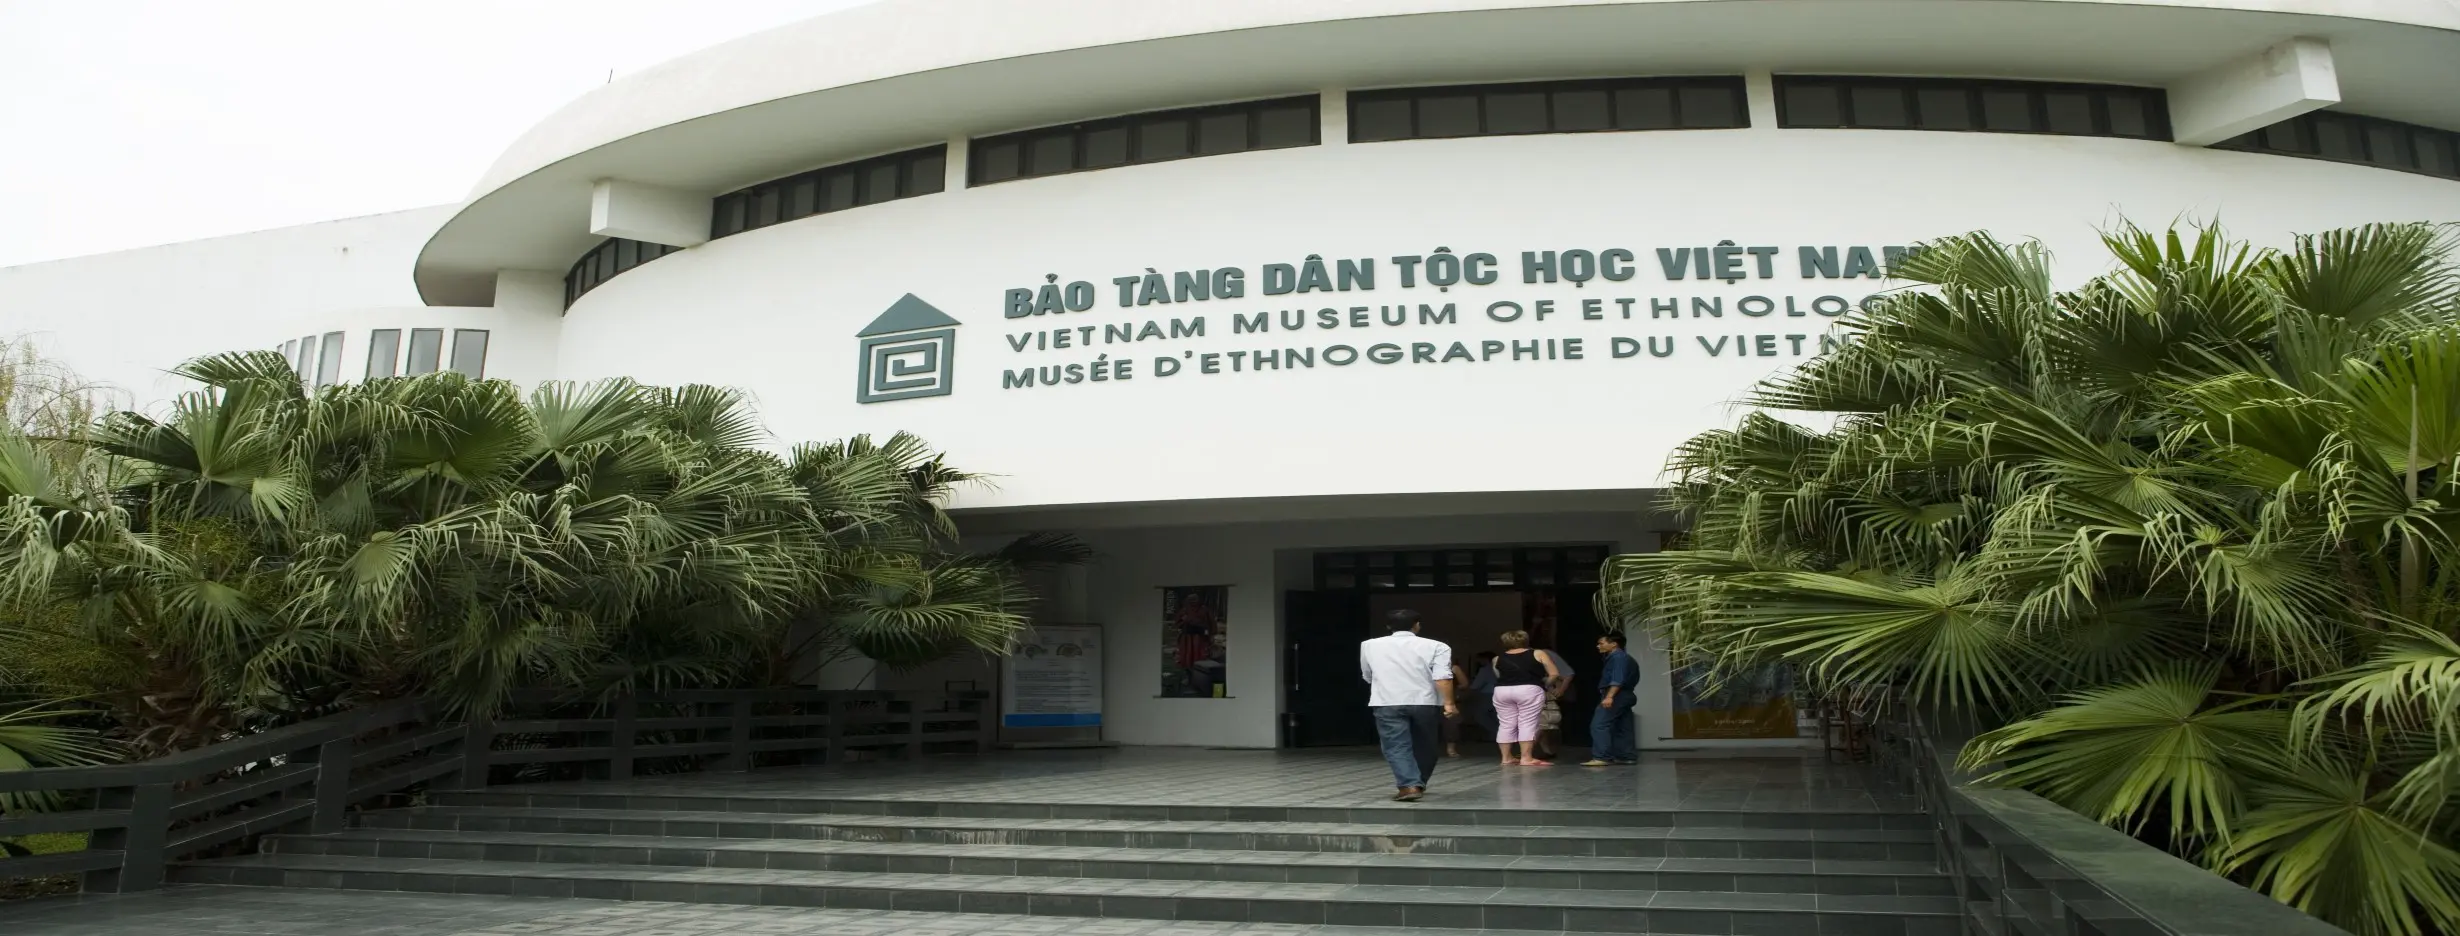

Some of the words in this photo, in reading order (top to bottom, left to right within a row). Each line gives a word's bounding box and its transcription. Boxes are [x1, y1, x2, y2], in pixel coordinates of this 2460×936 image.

[1004, 272, 1095, 320] BẢO
[1112, 266, 1245, 308] TÀNG
[1262, 253, 1376, 297] DÂN
[1391, 246, 1499, 293] TỘC
[1521, 248, 1636, 289] HỌC
[1655, 239, 1780, 285] VIỆT
[1005, 316, 1206, 353] VIETNAM
[1233, 302, 1457, 335] MUSEUM
[1485, 299, 1555, 323] OF
[1002, 352, 1133, 390] MUSÉE
[1154, 337, 1584, 378] D'ETHNOGRAPHIE
[1610, 335, 1674, 359] DU
[1695, 334, 1850, 358] VIETN
